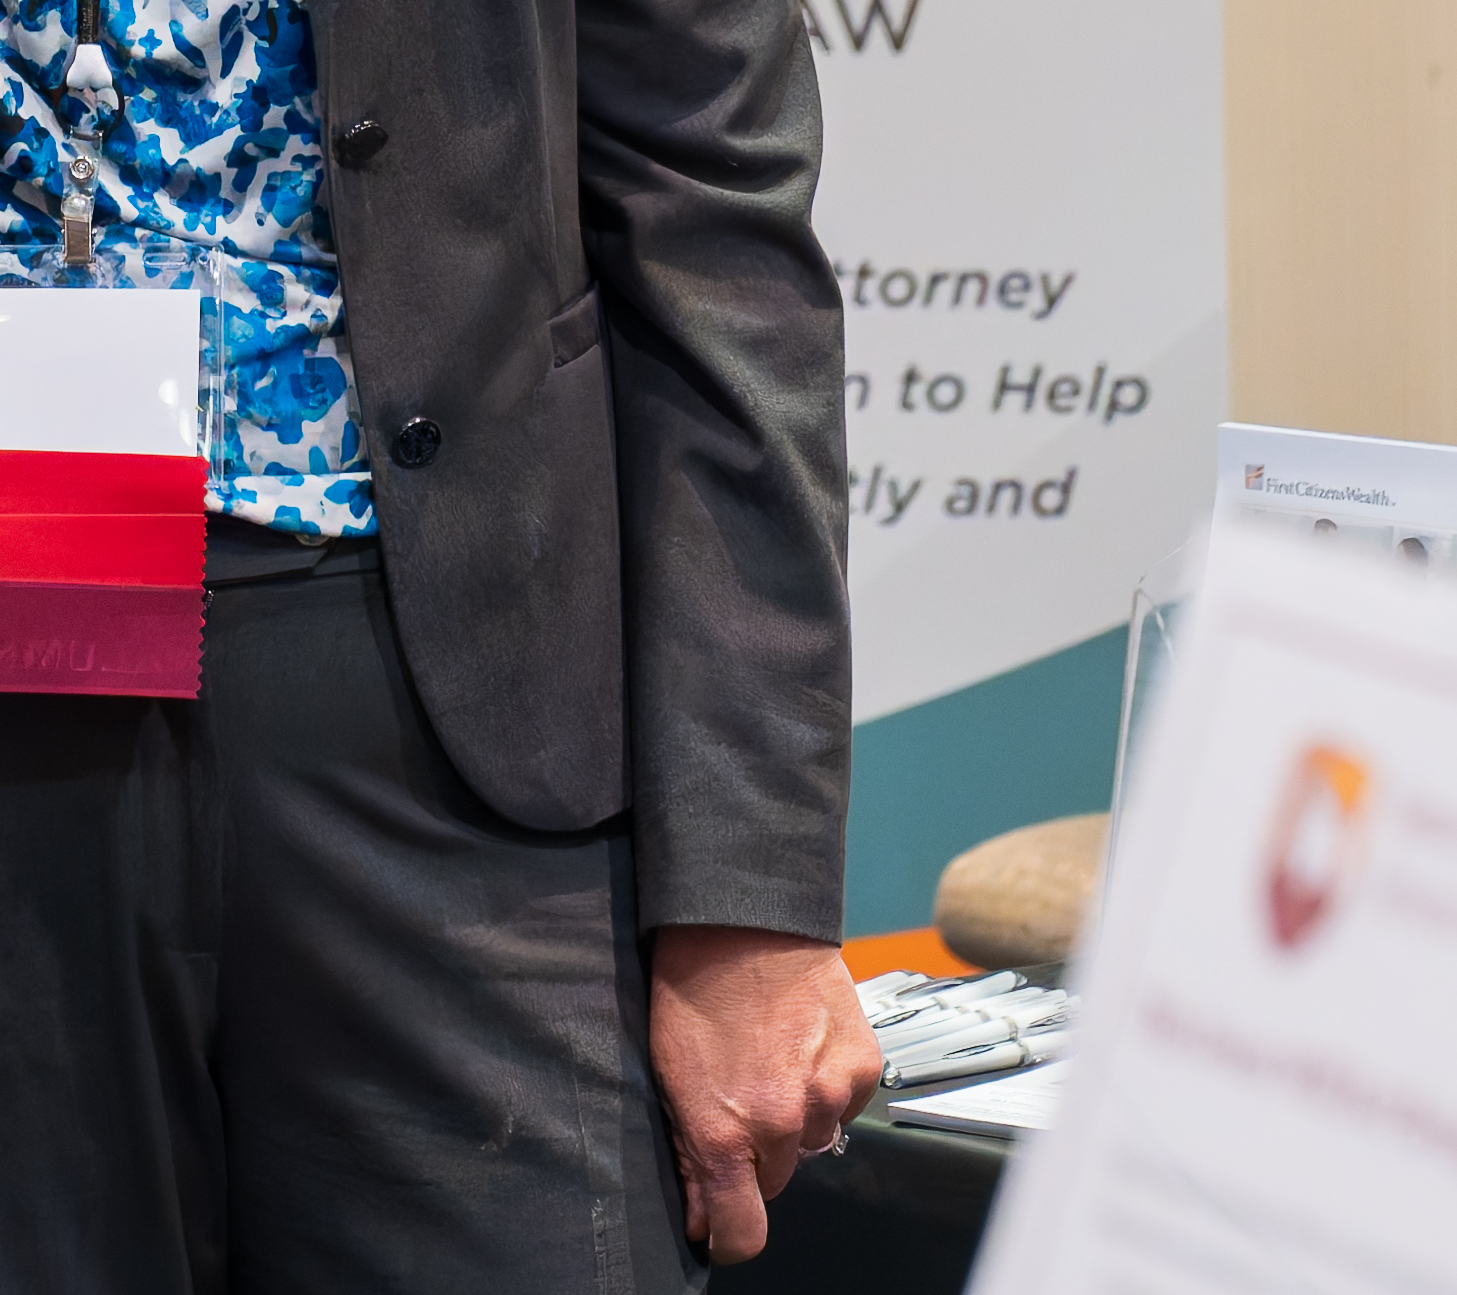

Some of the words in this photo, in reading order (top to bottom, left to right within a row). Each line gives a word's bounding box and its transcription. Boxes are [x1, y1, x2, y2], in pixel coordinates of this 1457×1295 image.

[900, 363, 965, 413] to
[992, 361, 1150, 425] Help
[944, 464, 1078, 518] and
